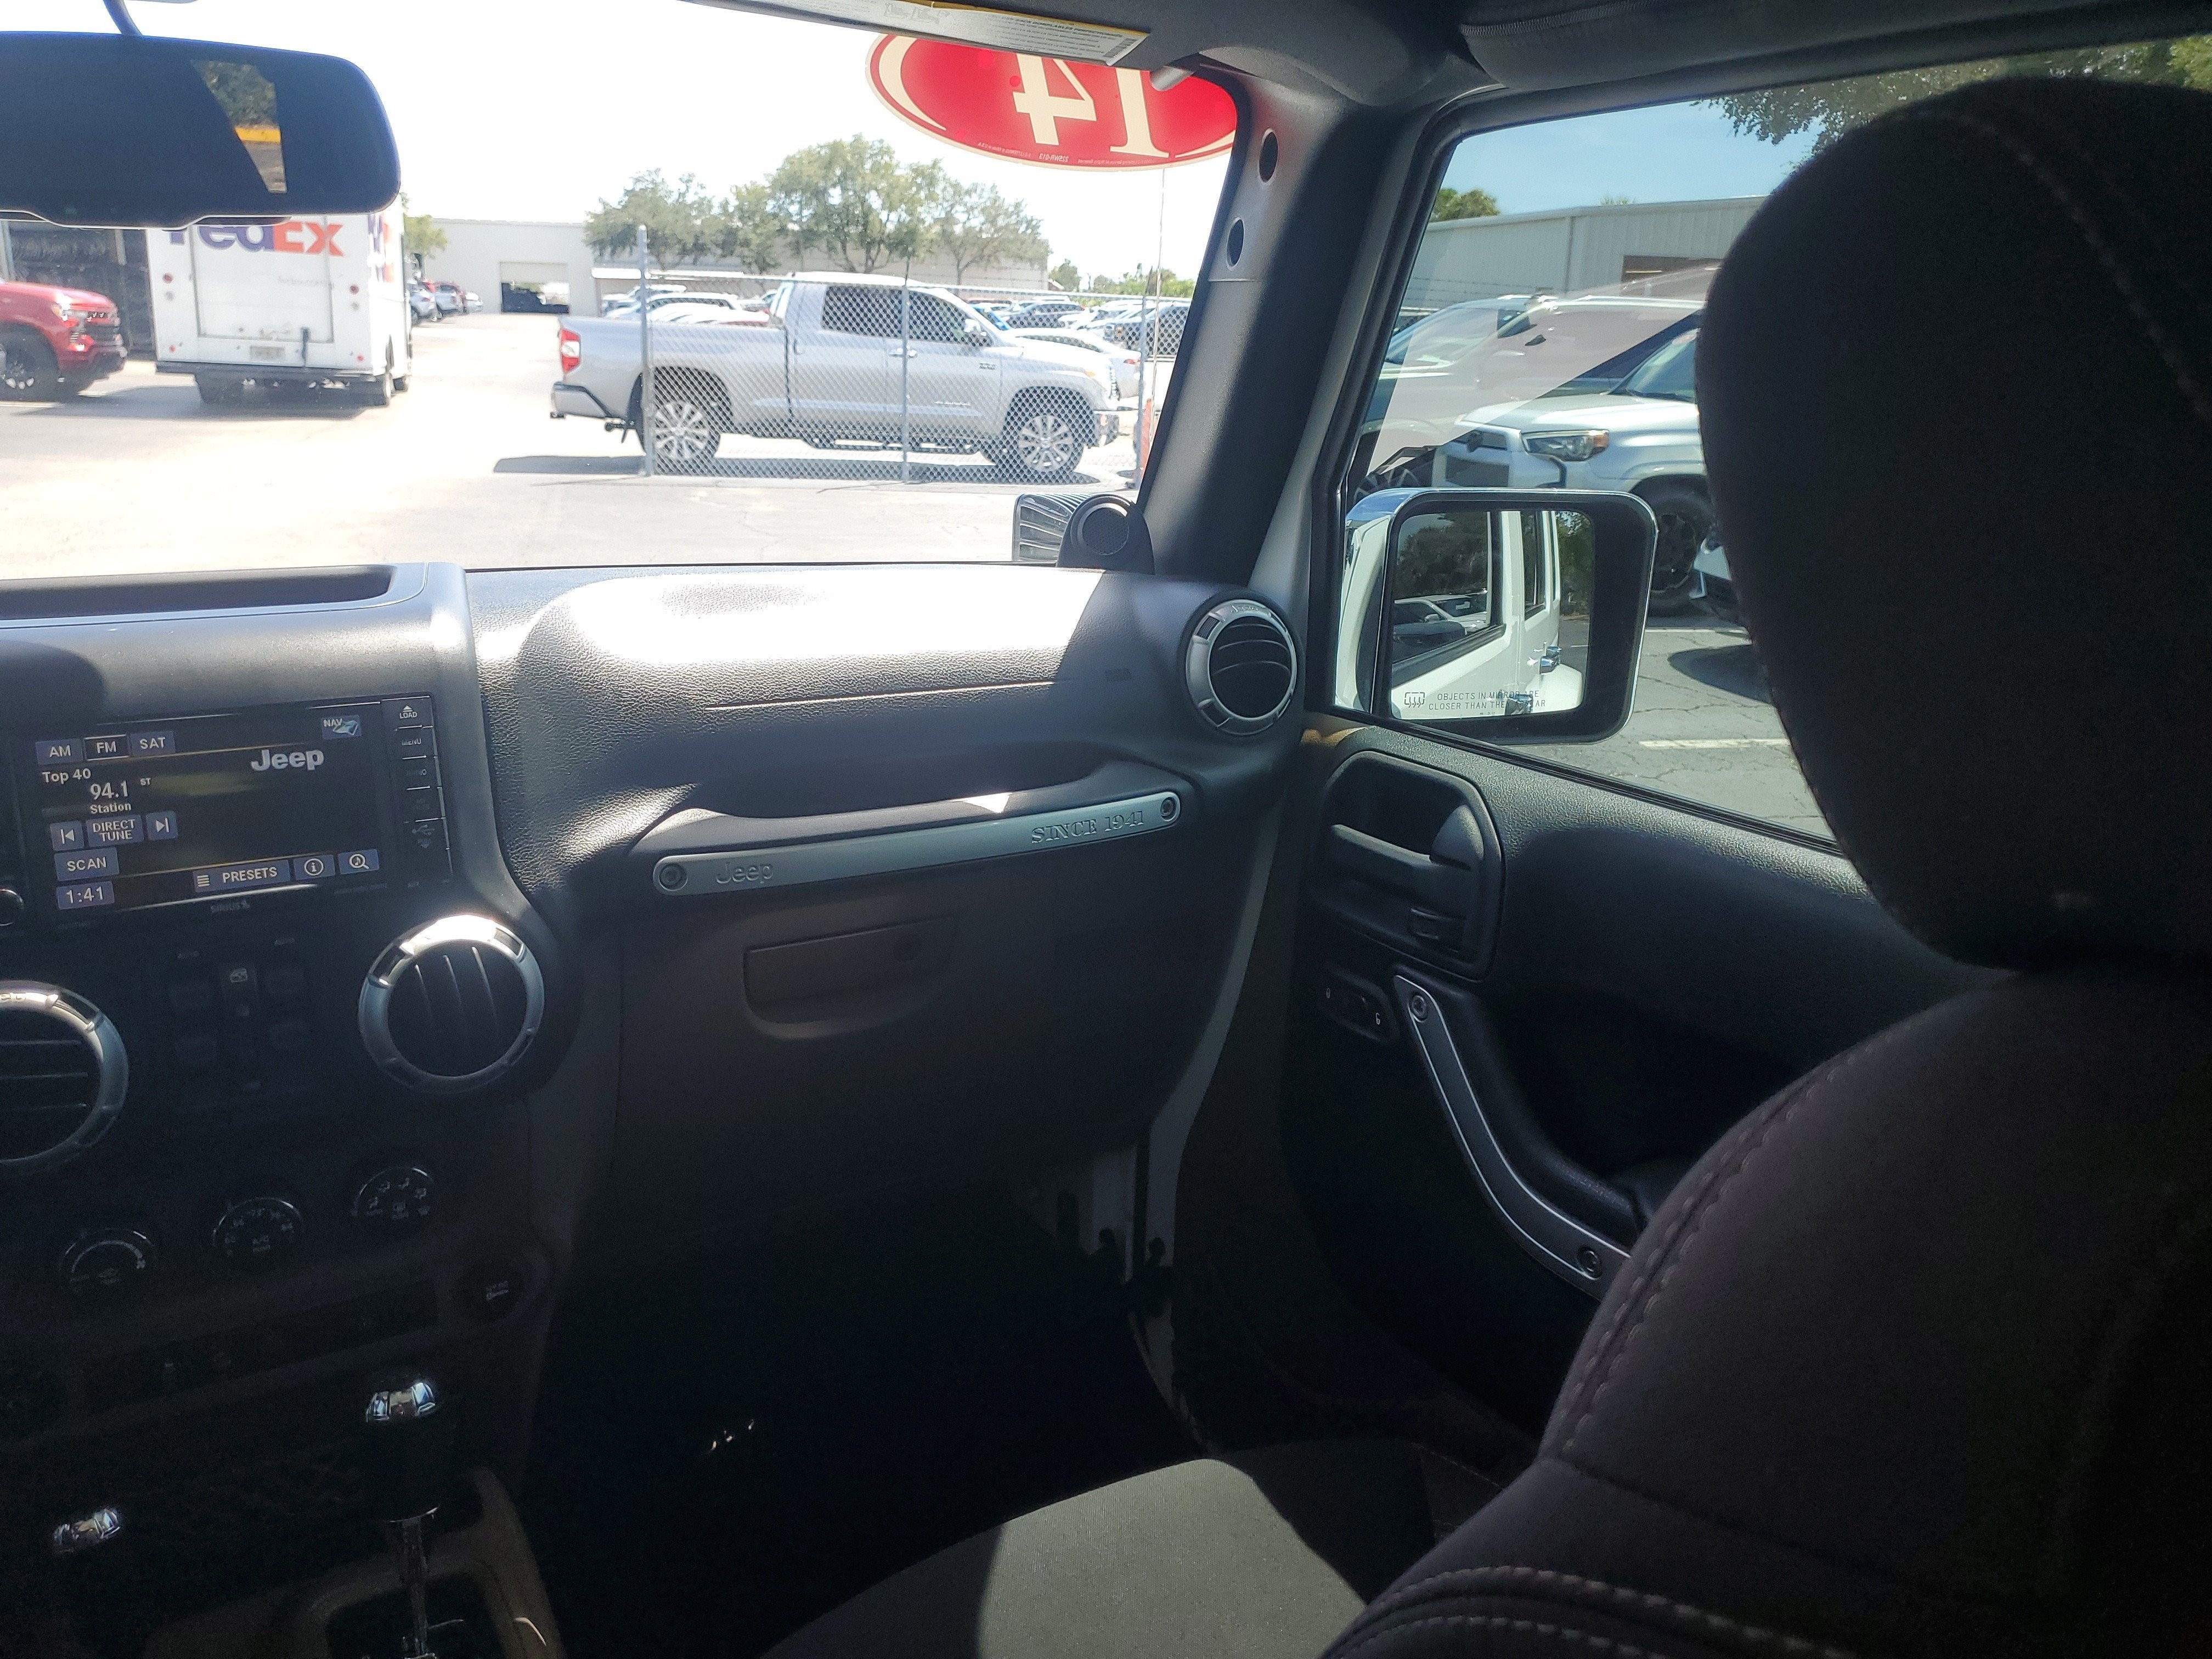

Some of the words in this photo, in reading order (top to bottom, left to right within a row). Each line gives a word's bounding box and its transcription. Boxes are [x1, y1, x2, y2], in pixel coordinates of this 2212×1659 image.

[169, 220, 345, 257] edEx
[323, 718, 343, 727] NAV
[49, 744, 72, 758] AM
[96, 741, 117, 754] FM
[139, 737, 166, 749] SAT
[251, 749, 325, 771] Jeep
[42, 771, 69, 785] Top
[72, 768, 92, 780] 40
[90, 780, 128, 800] 94.1
[89, 802, 132, 814] Station
[92, 819, 136, 833] DIRECT
[1031, 819, 1097, 844] SINCE
[1104, 810, 1145, 832] 1941
[99, 830, 133, 842] TUNE
[66, 856, 107, 872] SCAN
[222, 866, 278, 883] PRESETS
[715, 861, 774, 884] Jeep
[65, 885, 104, 904] 1:41
